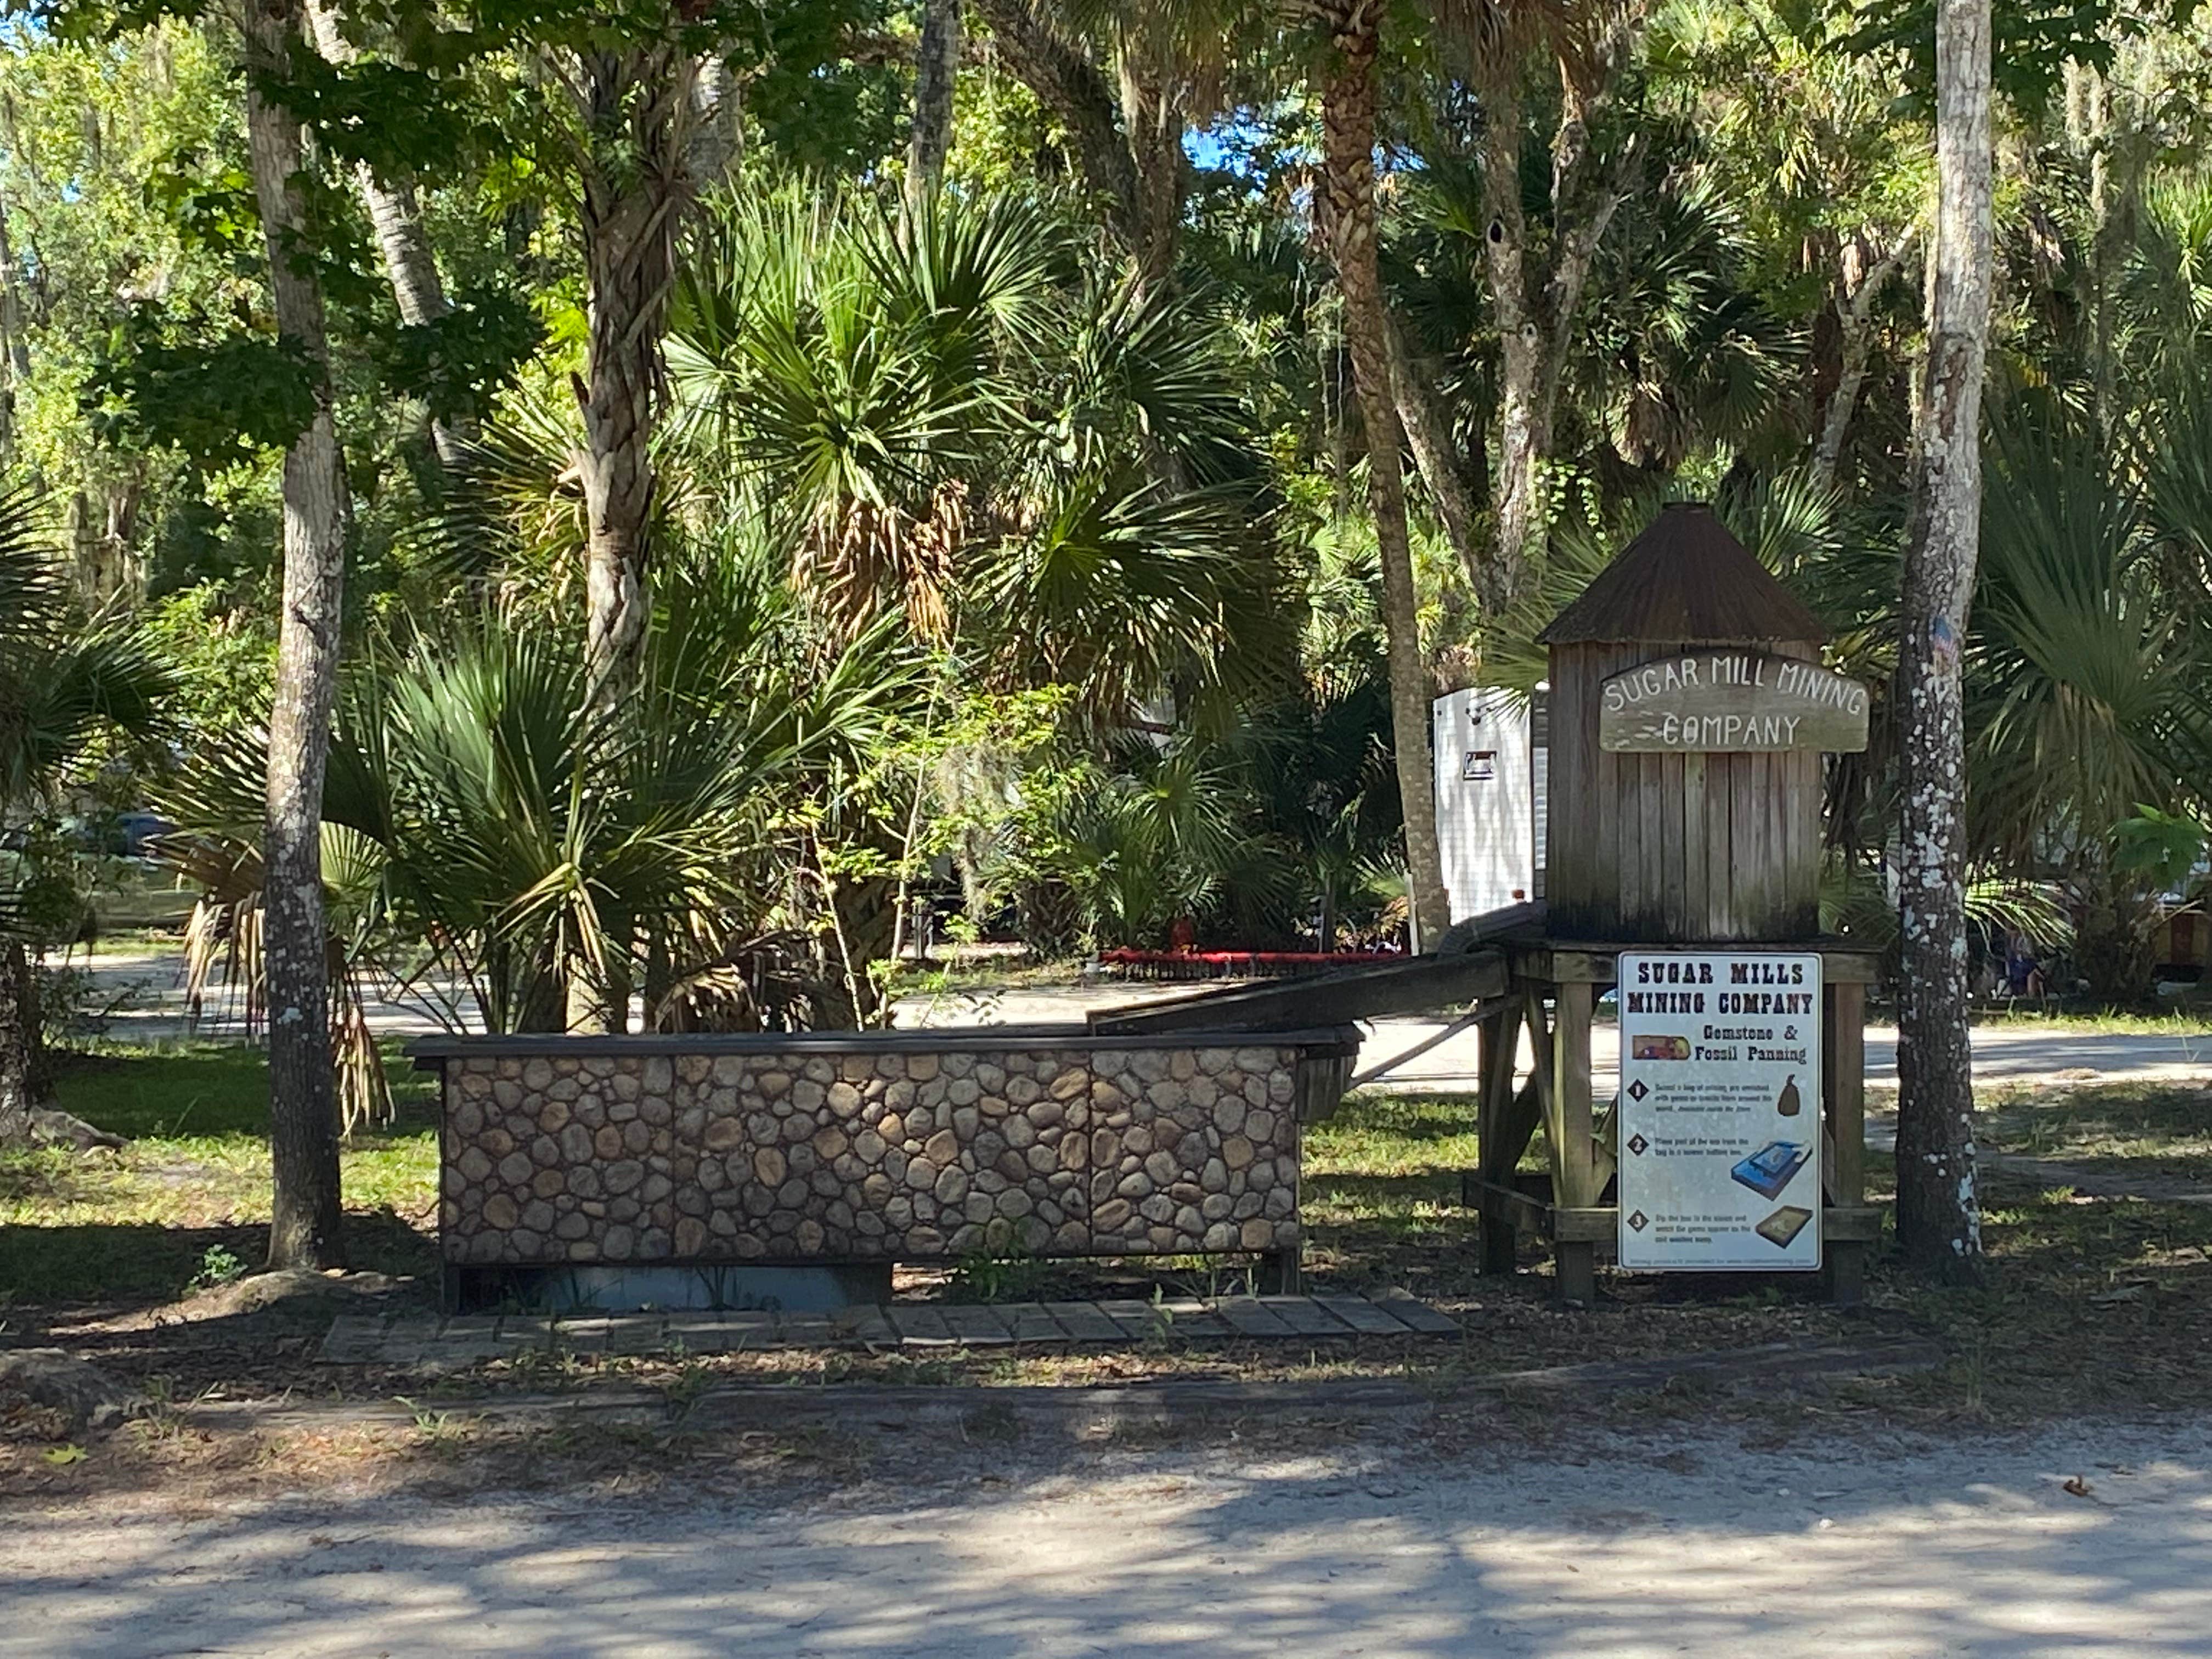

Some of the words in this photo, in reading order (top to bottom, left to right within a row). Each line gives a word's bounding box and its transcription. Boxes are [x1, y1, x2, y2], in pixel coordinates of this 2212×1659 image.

[1605, 658, 1699, 712] SUGAR
[1712, 656, 1765, 687] MILL
[1777, 662, 1866, 715] MINING
[1662, 715, 1801, 745] COMPANY
[1638, 962, 1713, 984] SUGAR
[1730, 962, 1803, 985] MILLS
[1627, 992, 1705, 1014] MINING
[1719, 992, 1813, 1014] COMPANY
[1703, 1025, 1774, 1040] Gemstone
[1784, 1025, 1798, 1041] &
[1695, 1045, 1737, 1061] Fossil
[1748, 1046, 1807, 1065] Panning
